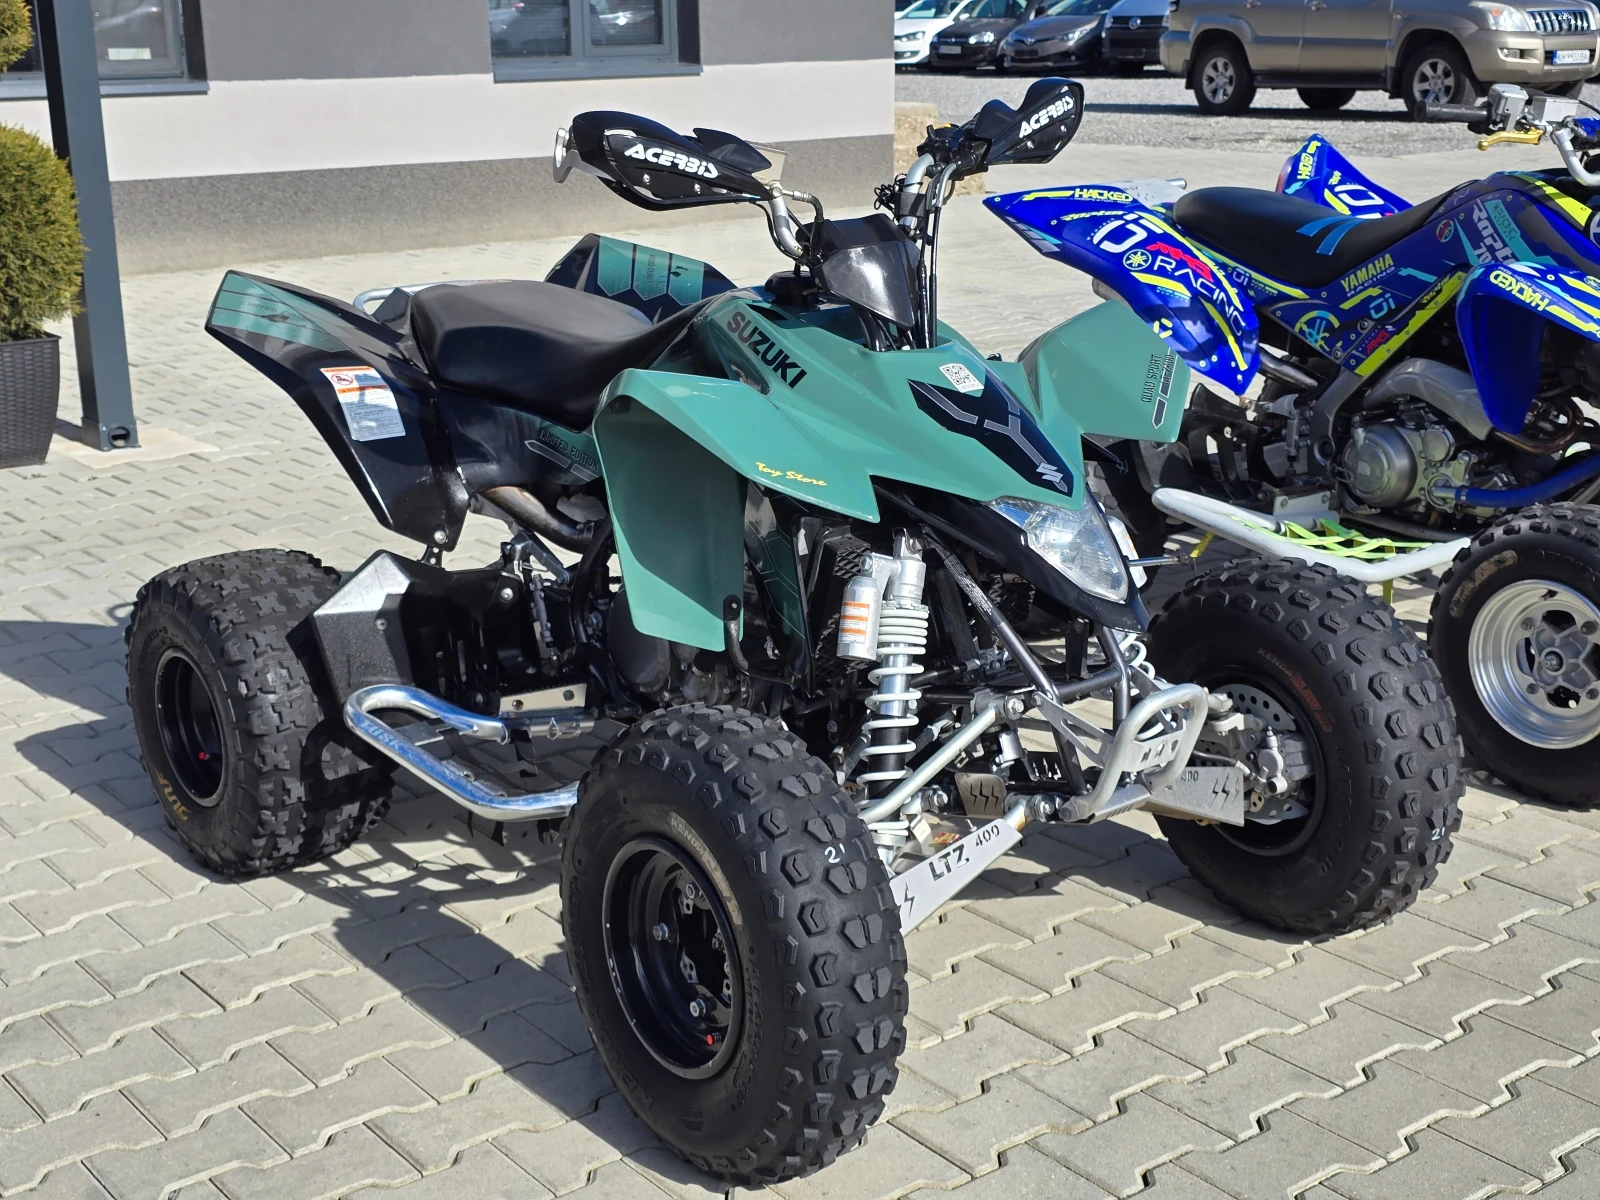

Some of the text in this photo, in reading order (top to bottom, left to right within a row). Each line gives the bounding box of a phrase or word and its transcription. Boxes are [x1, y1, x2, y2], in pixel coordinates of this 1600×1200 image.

[1019, 95, 1074, 138] ACERBIS
[624, 143, 719, 178] ACERBIS
[1074, 187, 1134, 202] HACKED
[1340, 253, 1394, 292] YAMAHA
[1346, 266, 1396, 297] RACING
[1489, 270, 1550, 311] HACKED
[1153, 255, 1246, 336] RACING
[726, 311, 808, 390] SUZUKI
[1141, 354, 1163, 403] QUAD SPORT
[539, 428, 569, 454] LIMITED
[755, 460, 828, 486] Toy Store
[1257, 647, 1294, 679] KENDA
[360, 719, 406, 751] TUSK
[669, 817, 705, 856] KENDA
[928, 823, 1001, 883] LTZ 400
